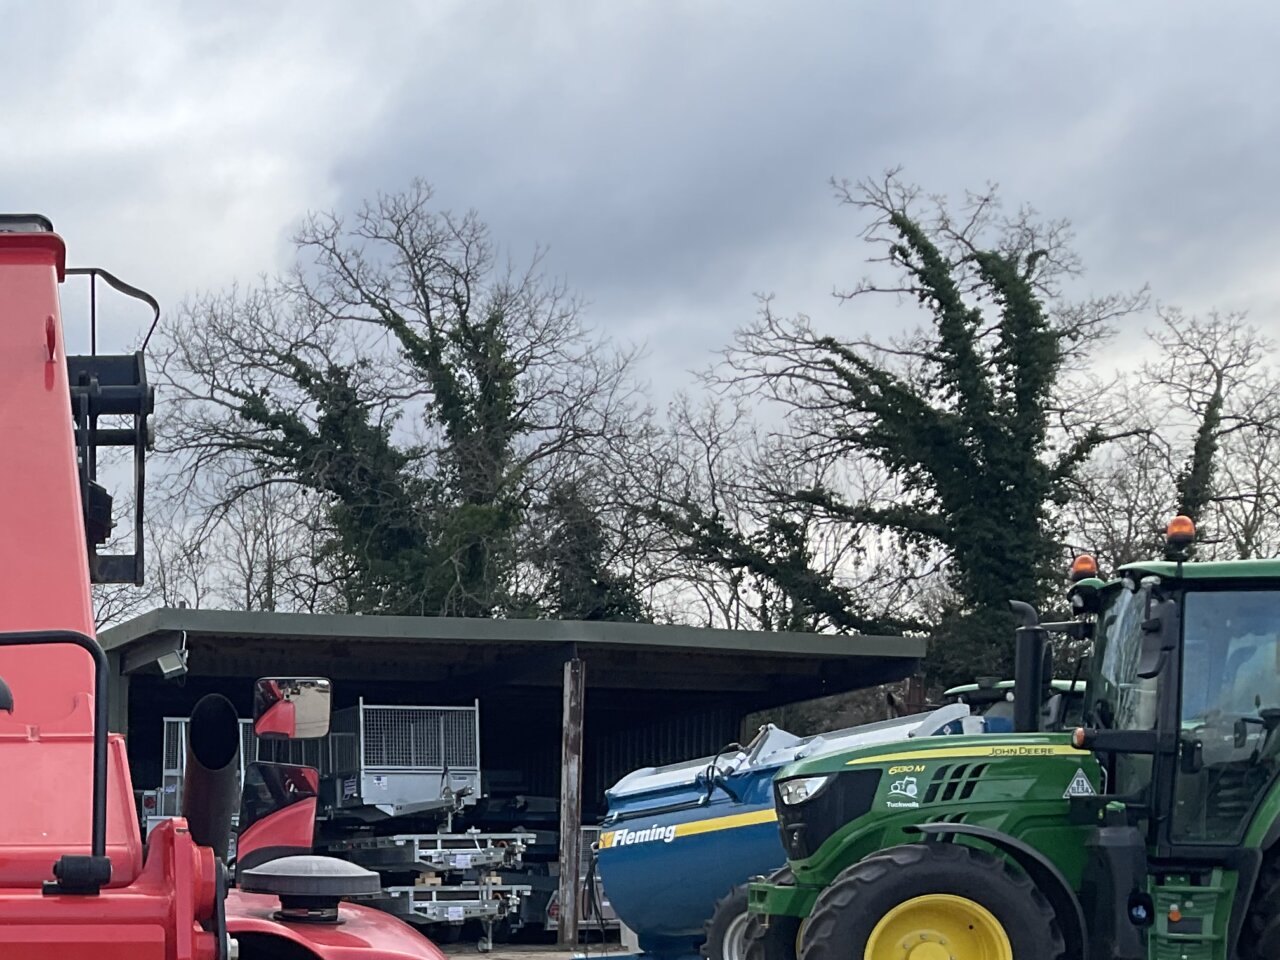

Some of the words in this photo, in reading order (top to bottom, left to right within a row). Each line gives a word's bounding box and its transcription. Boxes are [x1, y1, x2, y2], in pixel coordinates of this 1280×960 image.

[989, 747, 1017, 756] JOHN
[1019, 746, 1055, 755] DEERE
[611, 824, 677, 847] Fleming
